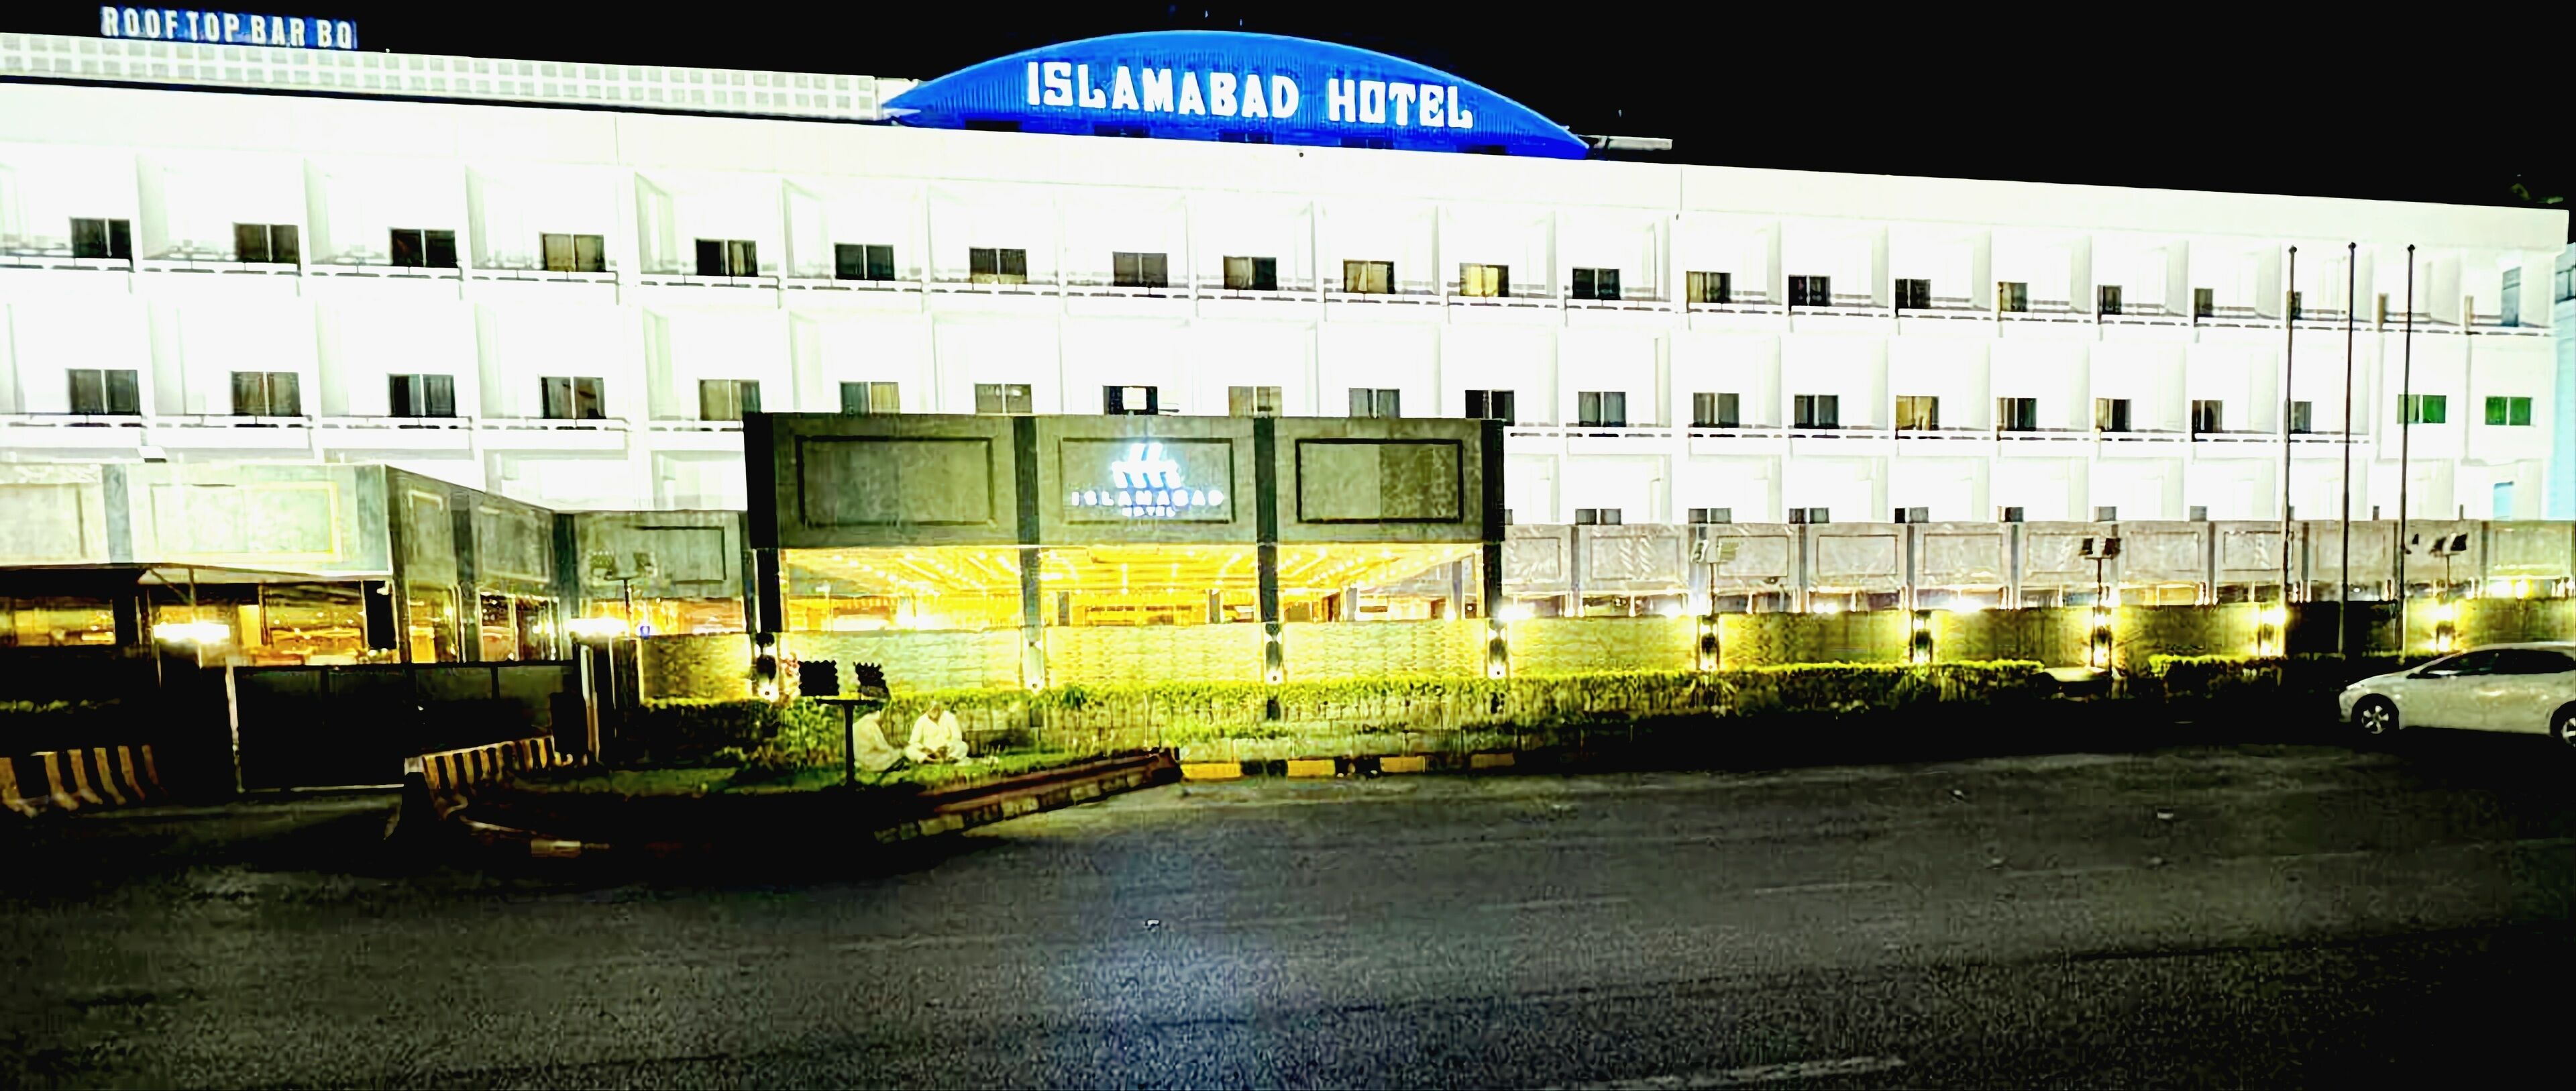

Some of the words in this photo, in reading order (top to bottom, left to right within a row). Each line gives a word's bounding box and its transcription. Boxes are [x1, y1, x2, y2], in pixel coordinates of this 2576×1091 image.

[250, 15, 305, 46] BAR
[1028, 61, 1299, 118] ISLAMABAD
[1328, 78, 1473, 129] HOTEL
